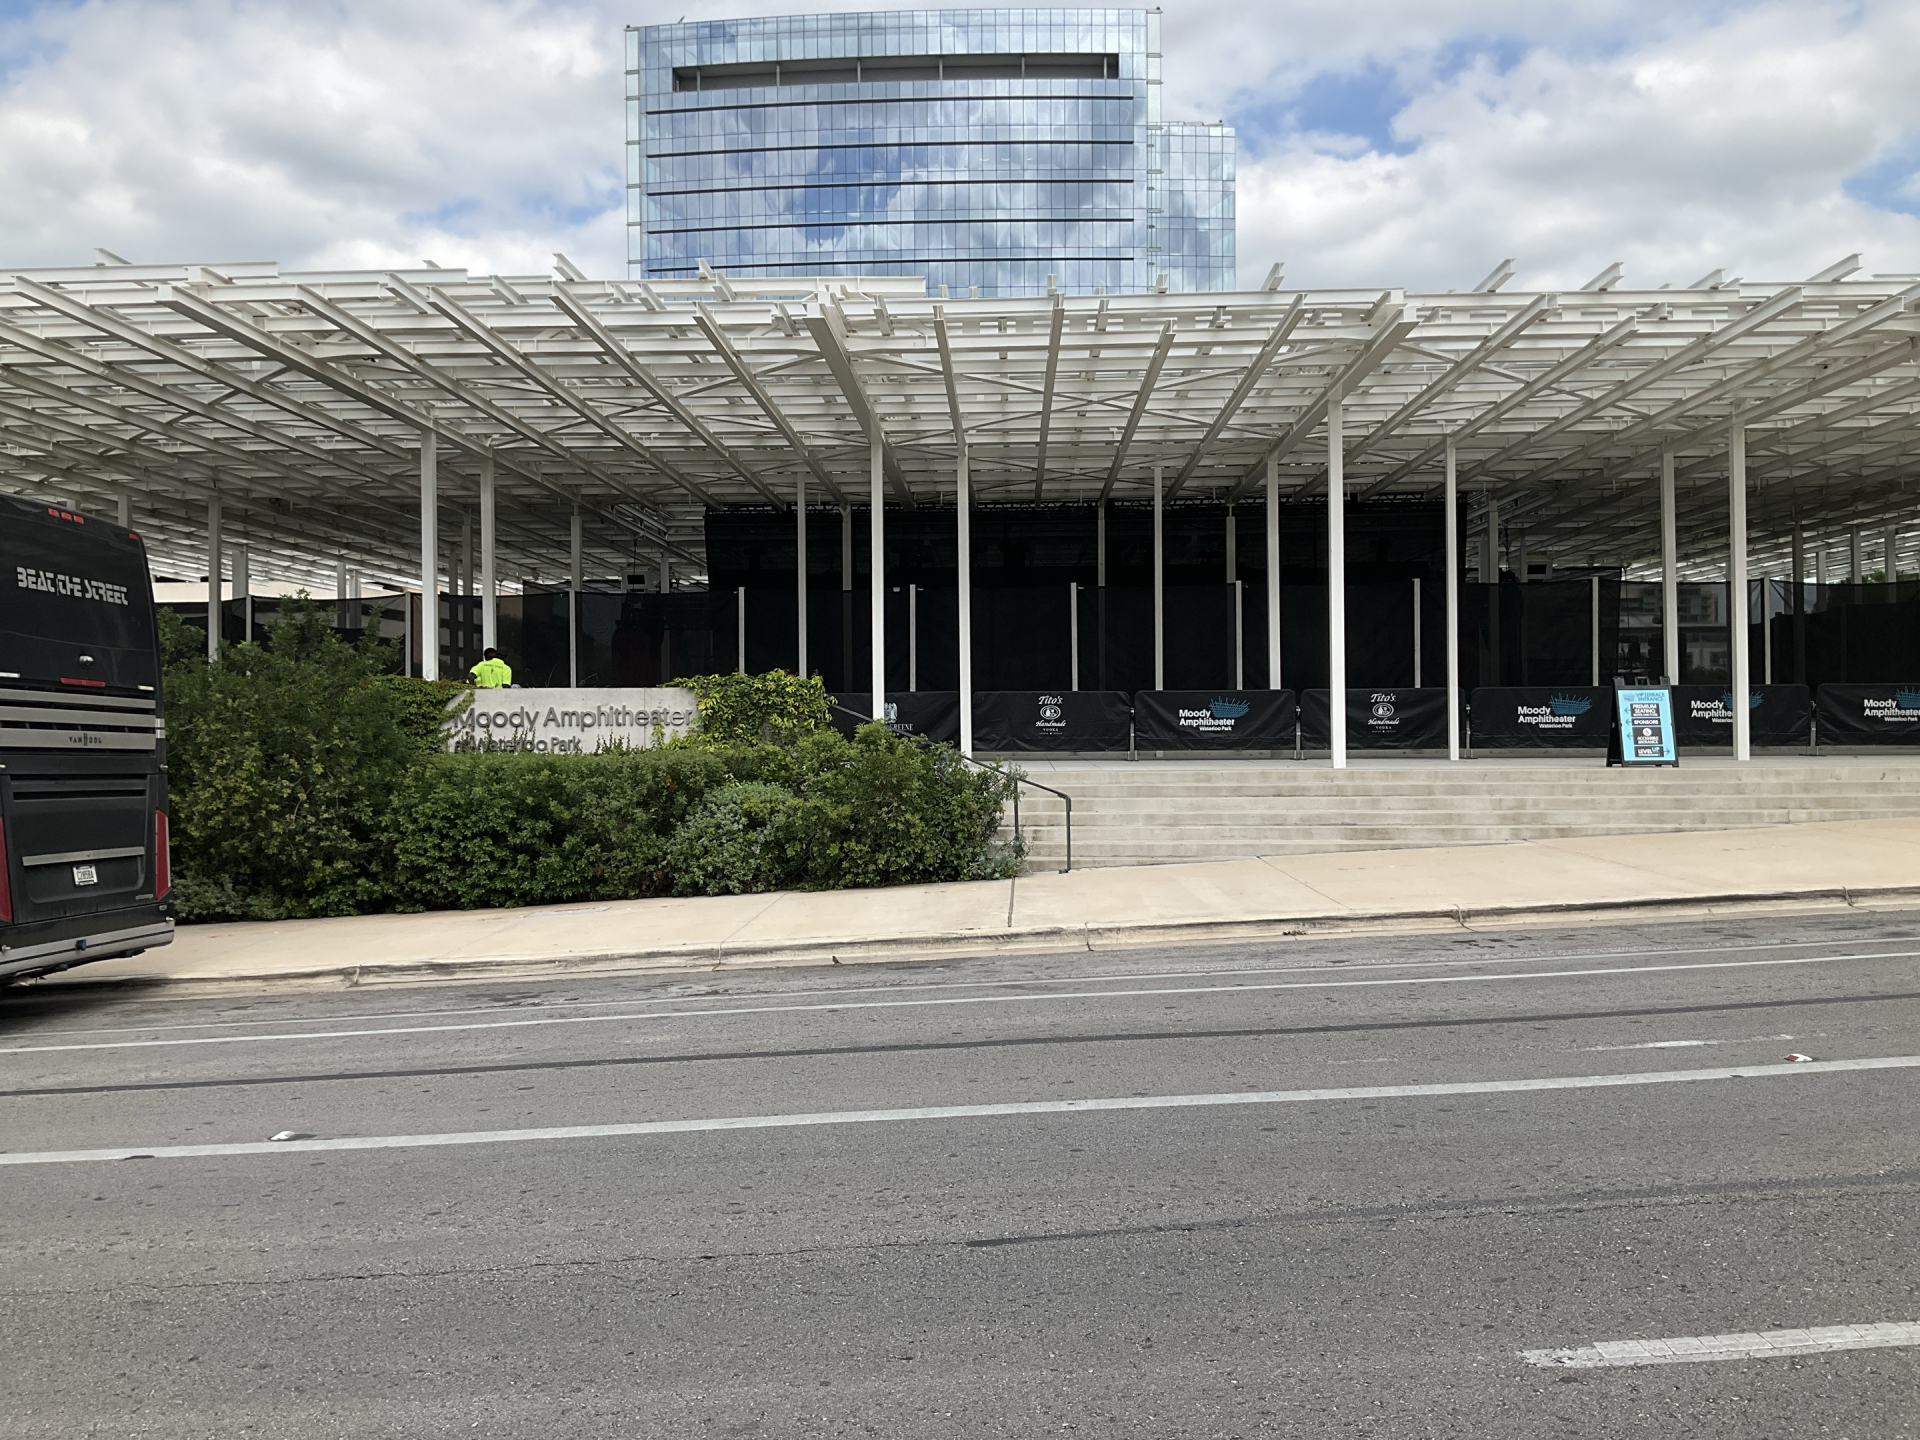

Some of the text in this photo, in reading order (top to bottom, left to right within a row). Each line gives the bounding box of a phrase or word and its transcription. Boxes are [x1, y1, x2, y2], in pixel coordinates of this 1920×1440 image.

[16, 566, 129, 606] BEAT THE STREET
[1038, 694, 1064, 705] Tito's
[1370, 692, 1397, 703] Tito's
[1691, 700, 1724, 709] Moody
[1864, 699, 1897, 708] Moody
[1179, 709, 1211, 718] Moody
[1518, 706, 1551, 715] Moody
[1691, 709, 1734, 719] Amphithe
[1864, 708, 1920, 718] Amphitheater
[452, 705, 693, 732] Moody Amphitheater
[1179, 718, 1235, 727] Amphitheater
[1518, 715, 1576, 724] Amphitheater
[551, 736, 582, 752] Park
